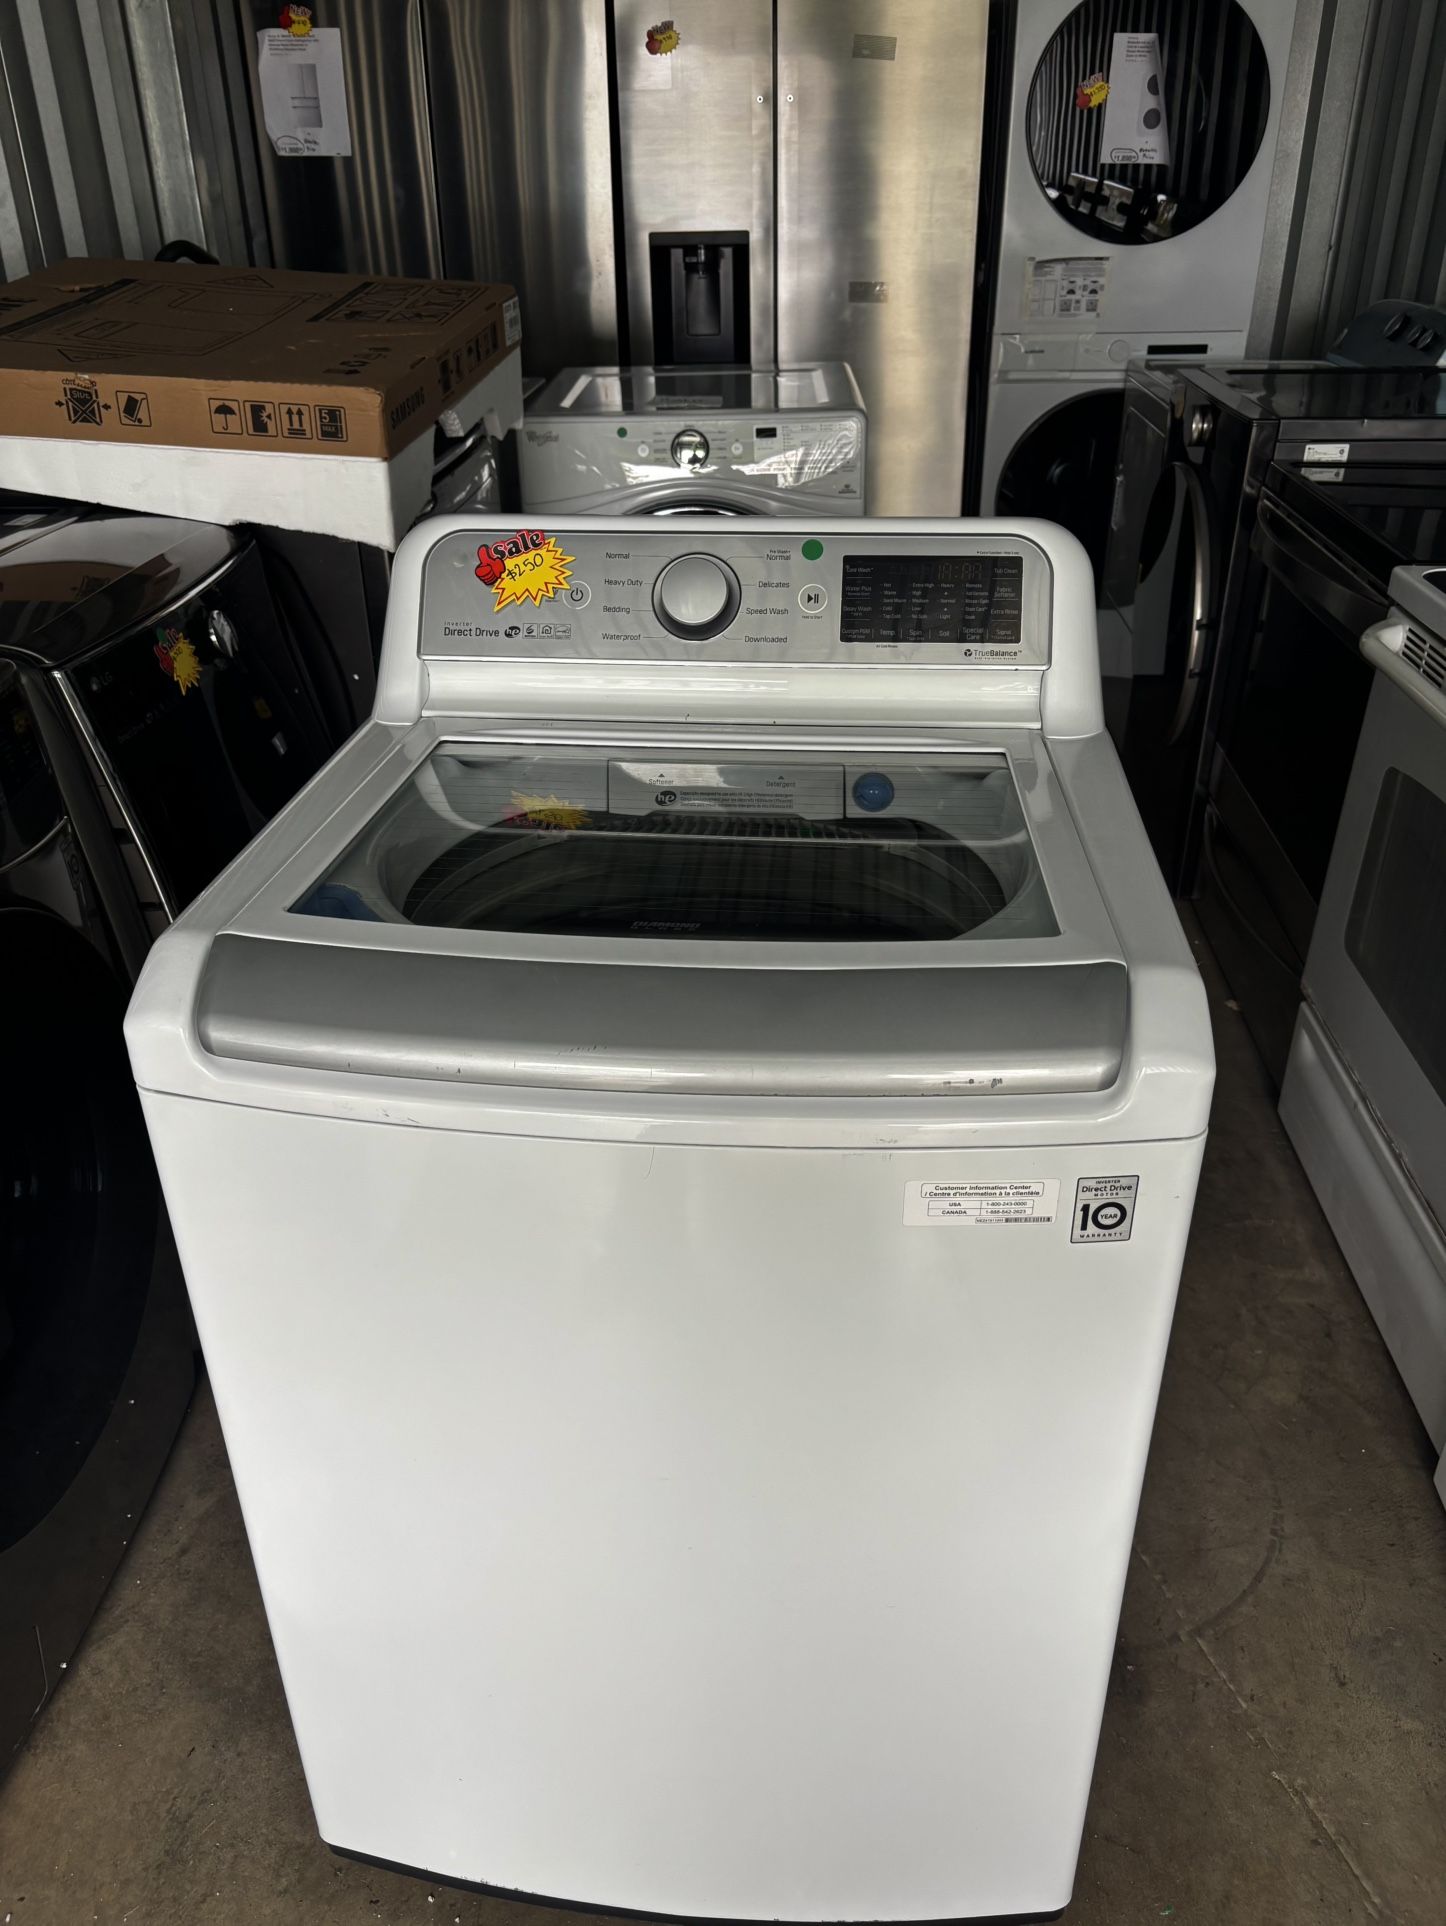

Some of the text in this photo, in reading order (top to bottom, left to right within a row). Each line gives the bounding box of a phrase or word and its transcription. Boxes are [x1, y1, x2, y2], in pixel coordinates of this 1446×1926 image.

[391, 386, 425, 430] SAMSUNG
[320, 410, 330, 423] 5
[506, 553, 543, 581] $250
[604, 579, 643, 587] Heavy Duty
[602, 605, 631, 614] Bedding
[746, 607, 789, 615] Speed Wash
[444, 627, 499, 637] Direct Drive
[601, 633, 641, 642] Waterproof
[744, 635, 788, 643] Downloaded
[649, 778, 674, 786] Softener
[766, 780, 796, 788] Detergent
[1080, 1202, 1127, 1231] 10
